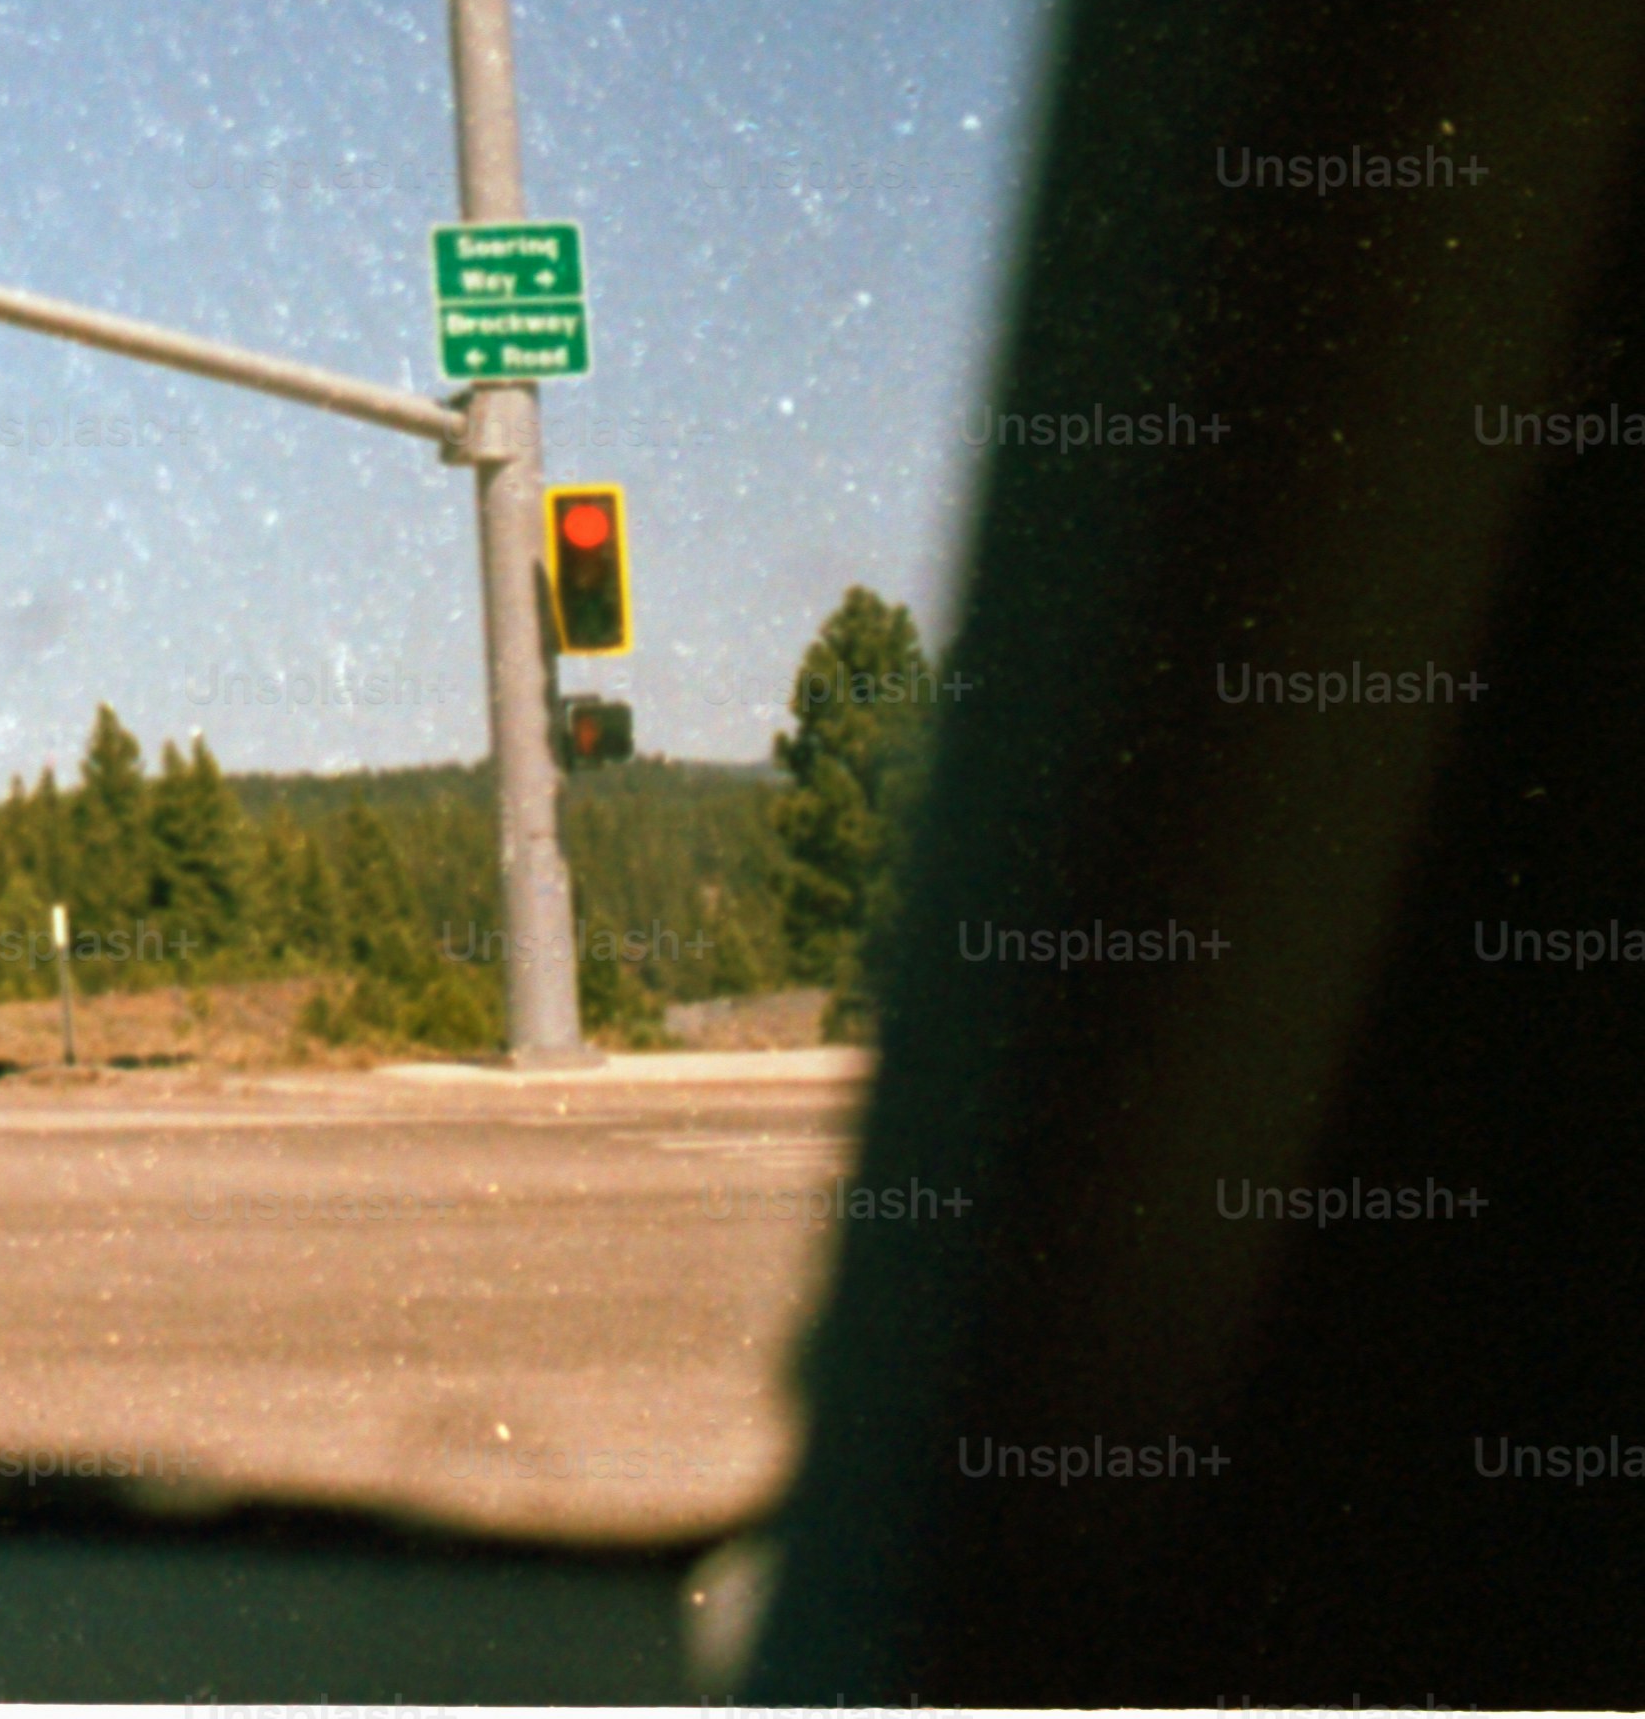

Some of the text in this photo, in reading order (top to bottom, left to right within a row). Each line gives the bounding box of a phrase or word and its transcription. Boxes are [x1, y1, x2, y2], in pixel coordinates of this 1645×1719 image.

[461, 271, 517, 297] Way
[446, 313, 577, 339] Brockway
[502, 345, 569, 369] Road
